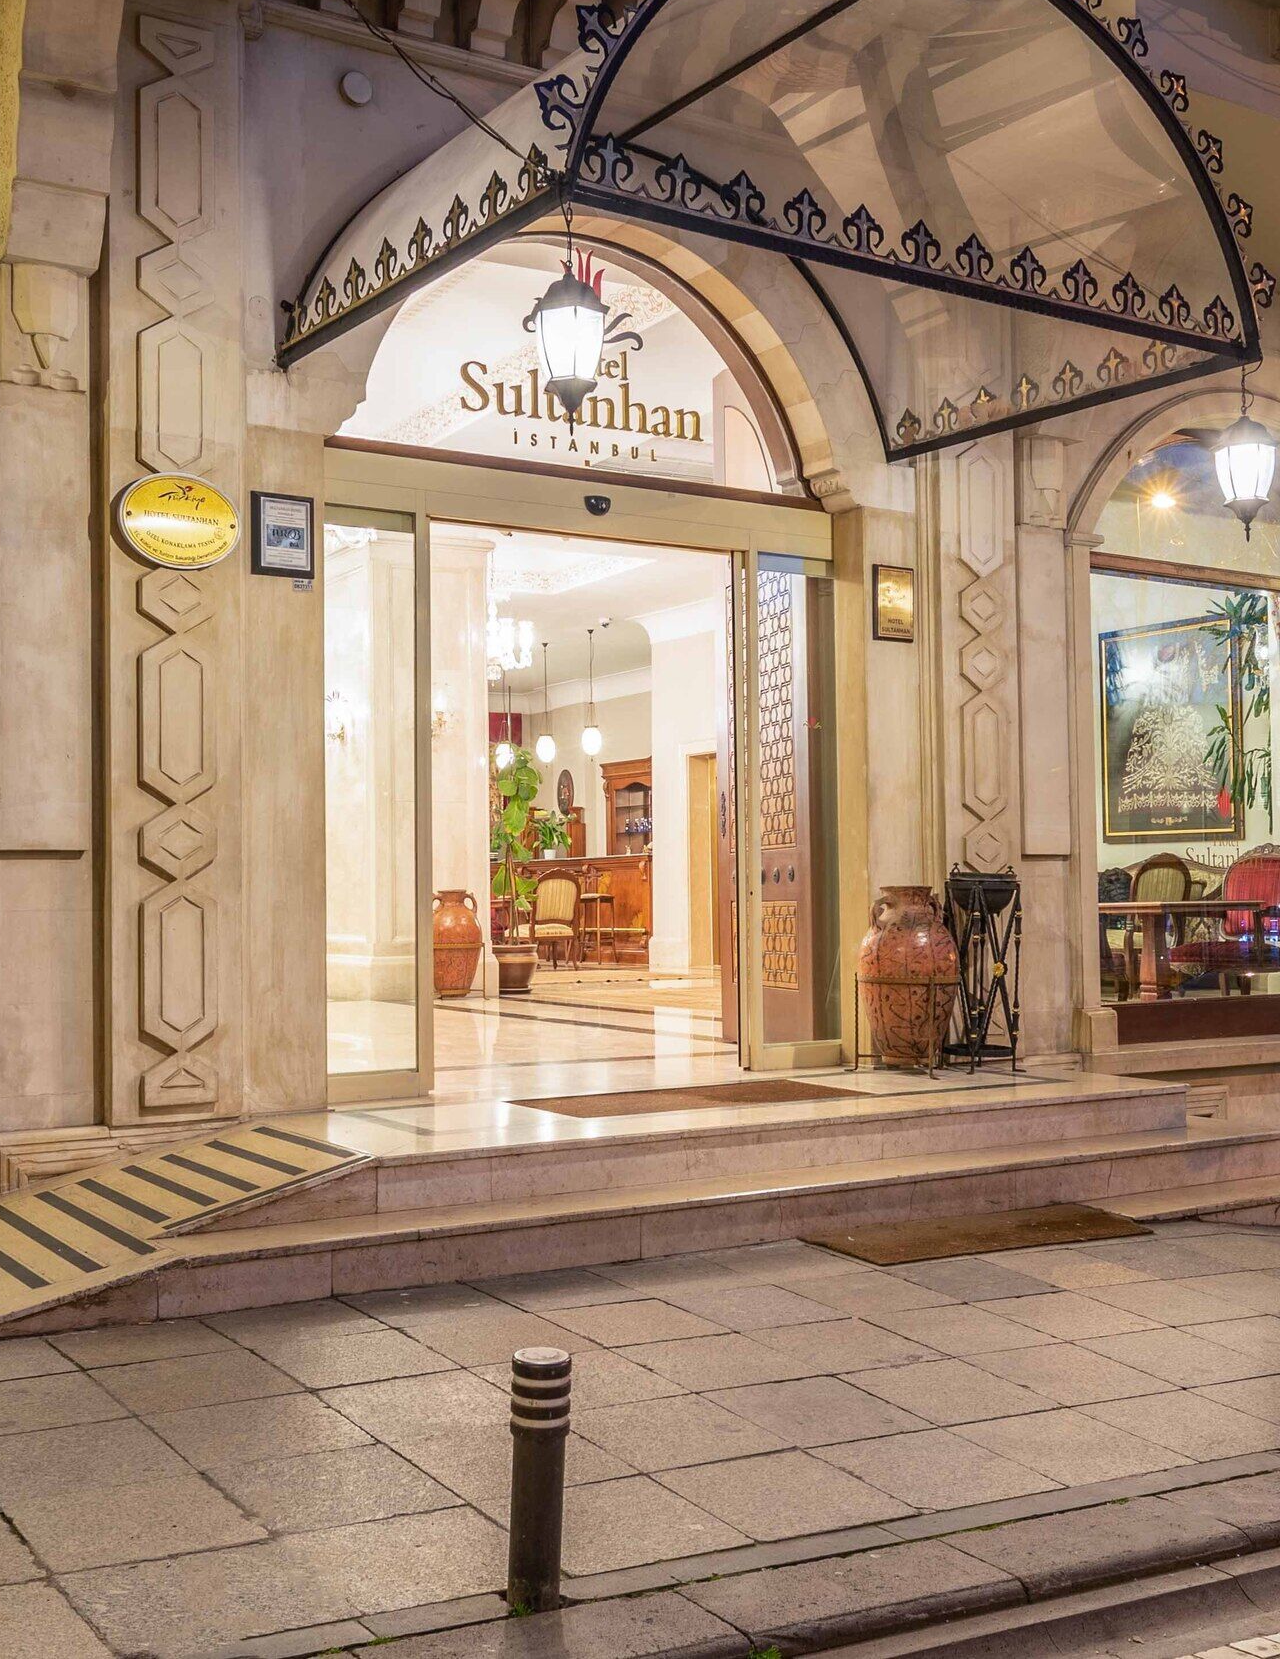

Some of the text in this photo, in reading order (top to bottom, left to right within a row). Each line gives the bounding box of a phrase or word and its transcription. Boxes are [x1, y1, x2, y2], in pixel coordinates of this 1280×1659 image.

[513, 428, 657, 462] İSTANBUL
[144, 510, 220, 526] HOTEL SULTANHAN
[881, 626, 911, 634] SULTANHAN
